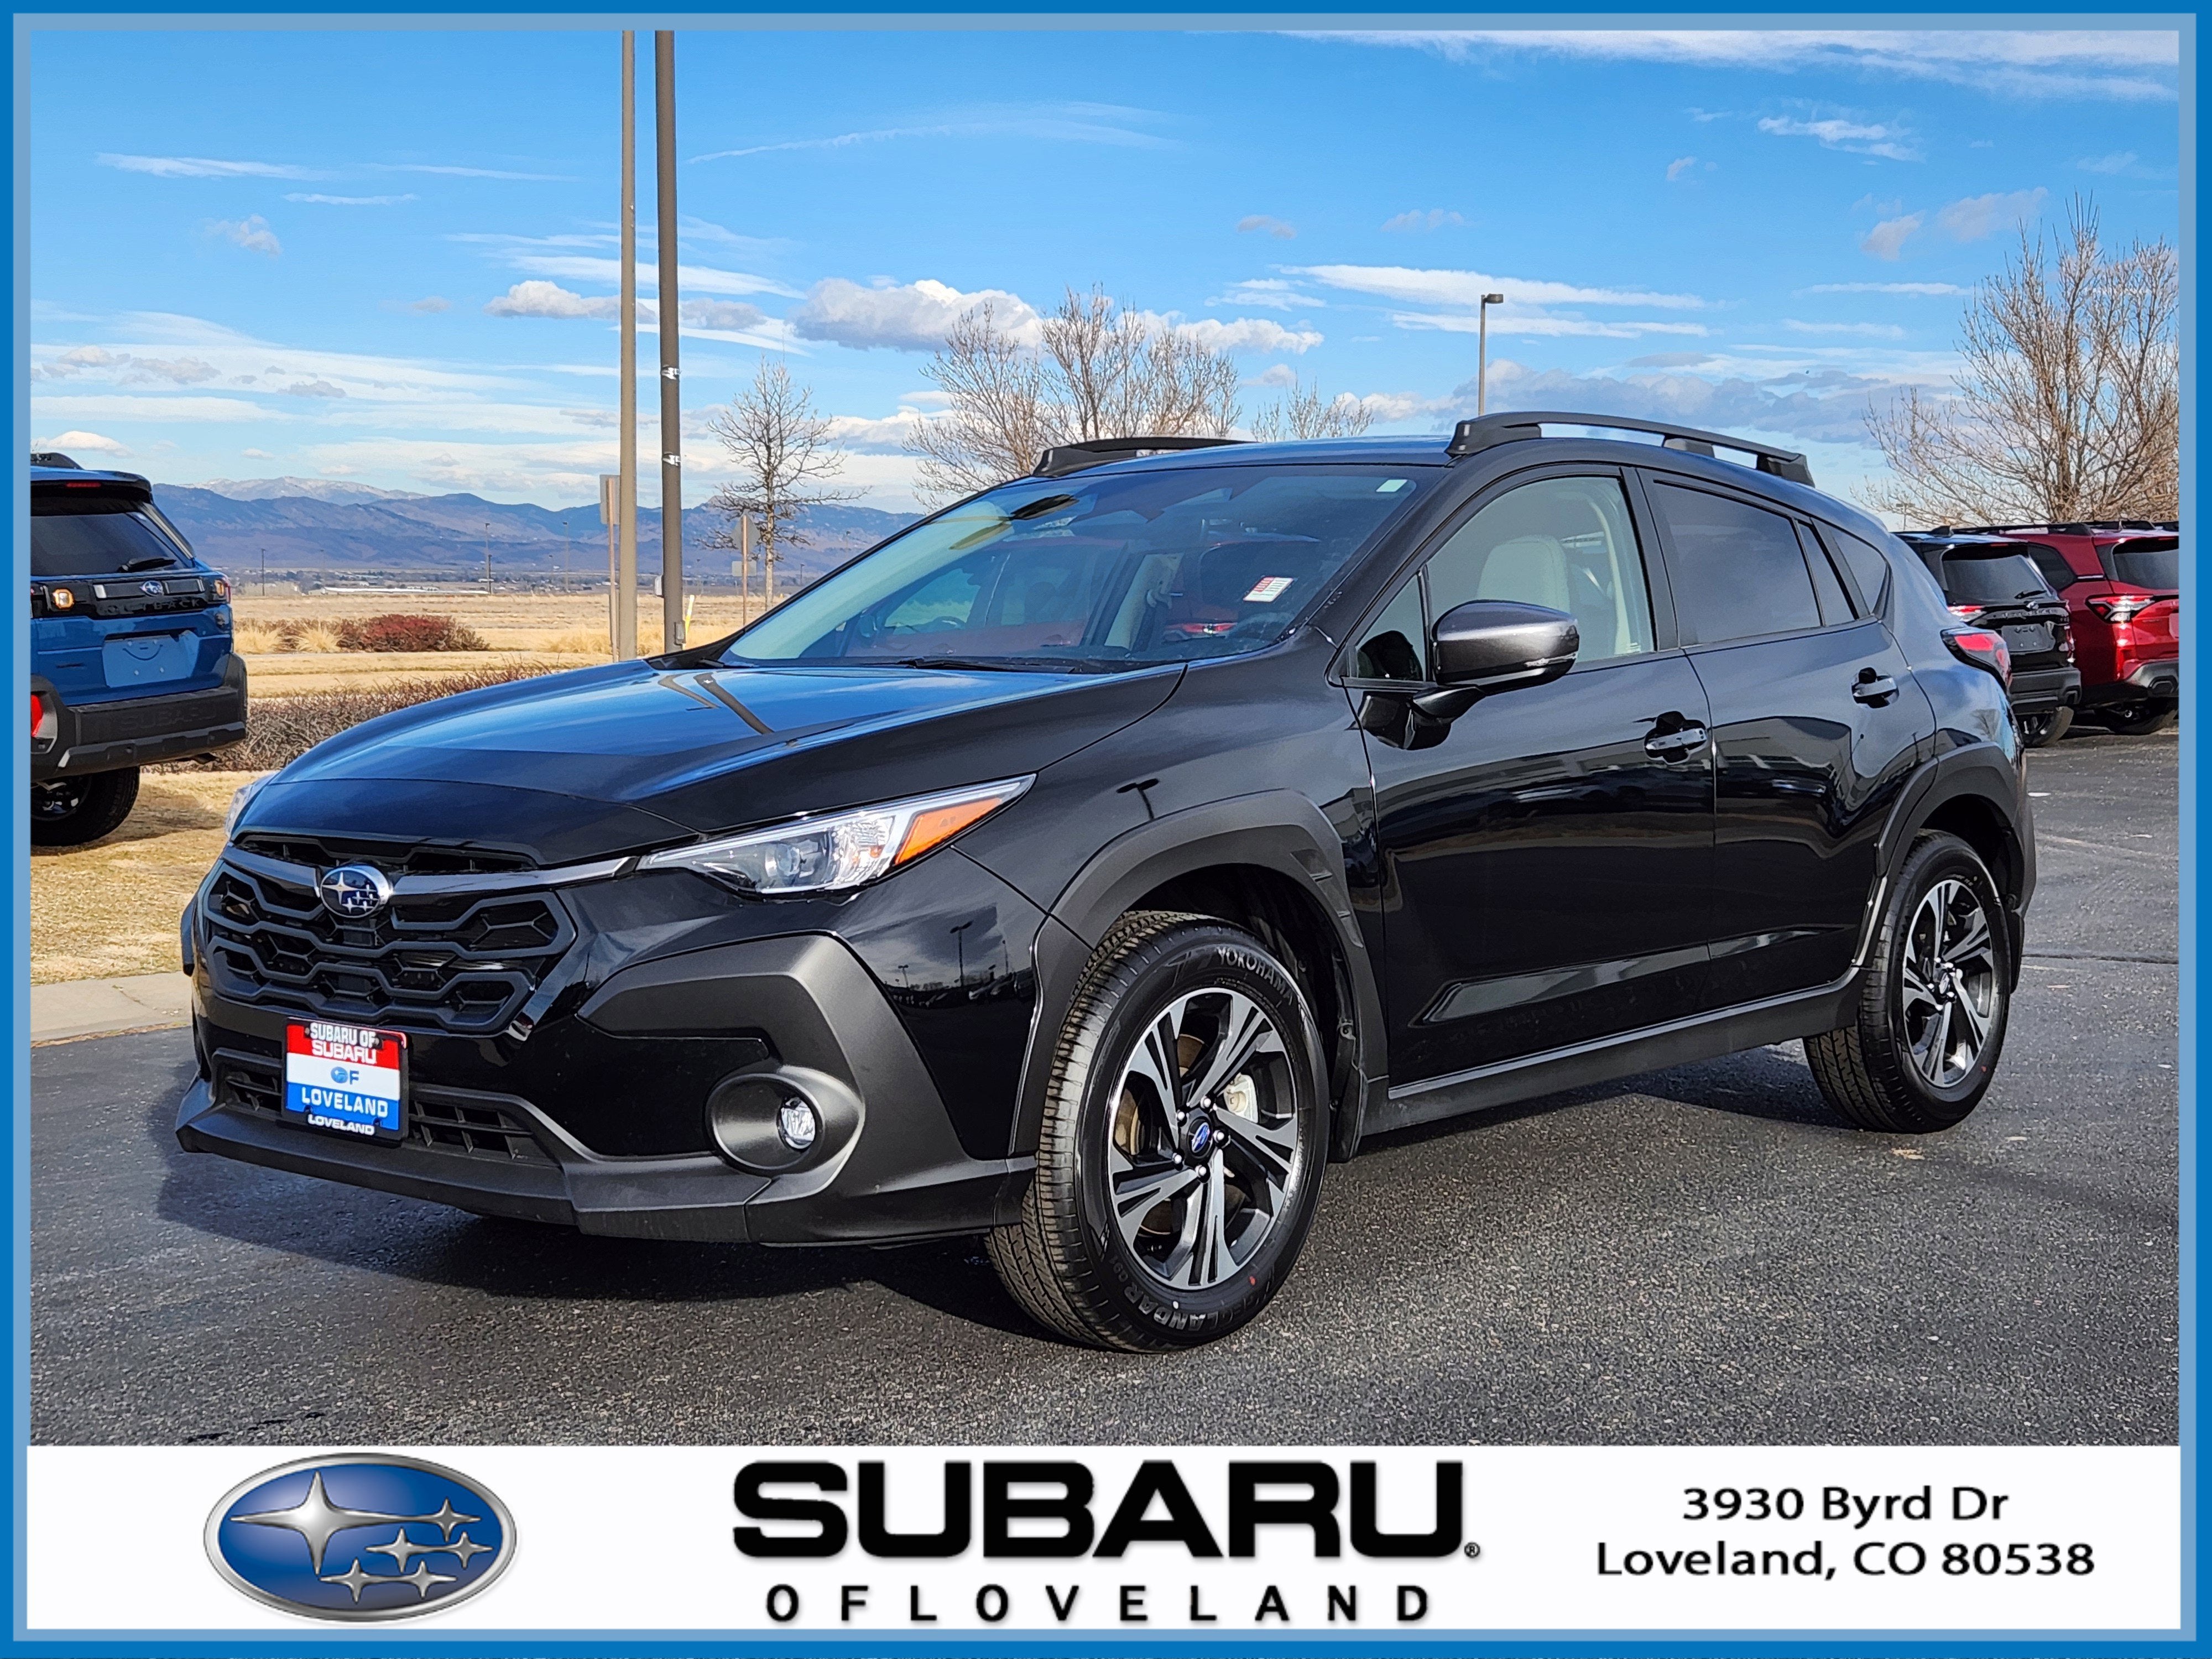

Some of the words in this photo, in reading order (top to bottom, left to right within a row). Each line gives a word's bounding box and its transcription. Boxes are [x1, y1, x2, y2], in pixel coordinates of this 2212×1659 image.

[310, 1022, 358, 1045] SUBARU
[359, 1030, 377, 1048] OF
[311, 1040, 377, 1065] SUBARU
[301, 1086, 388, 1118] LOVELAND
[307, 1114, 375, 1136] LOVELAND
